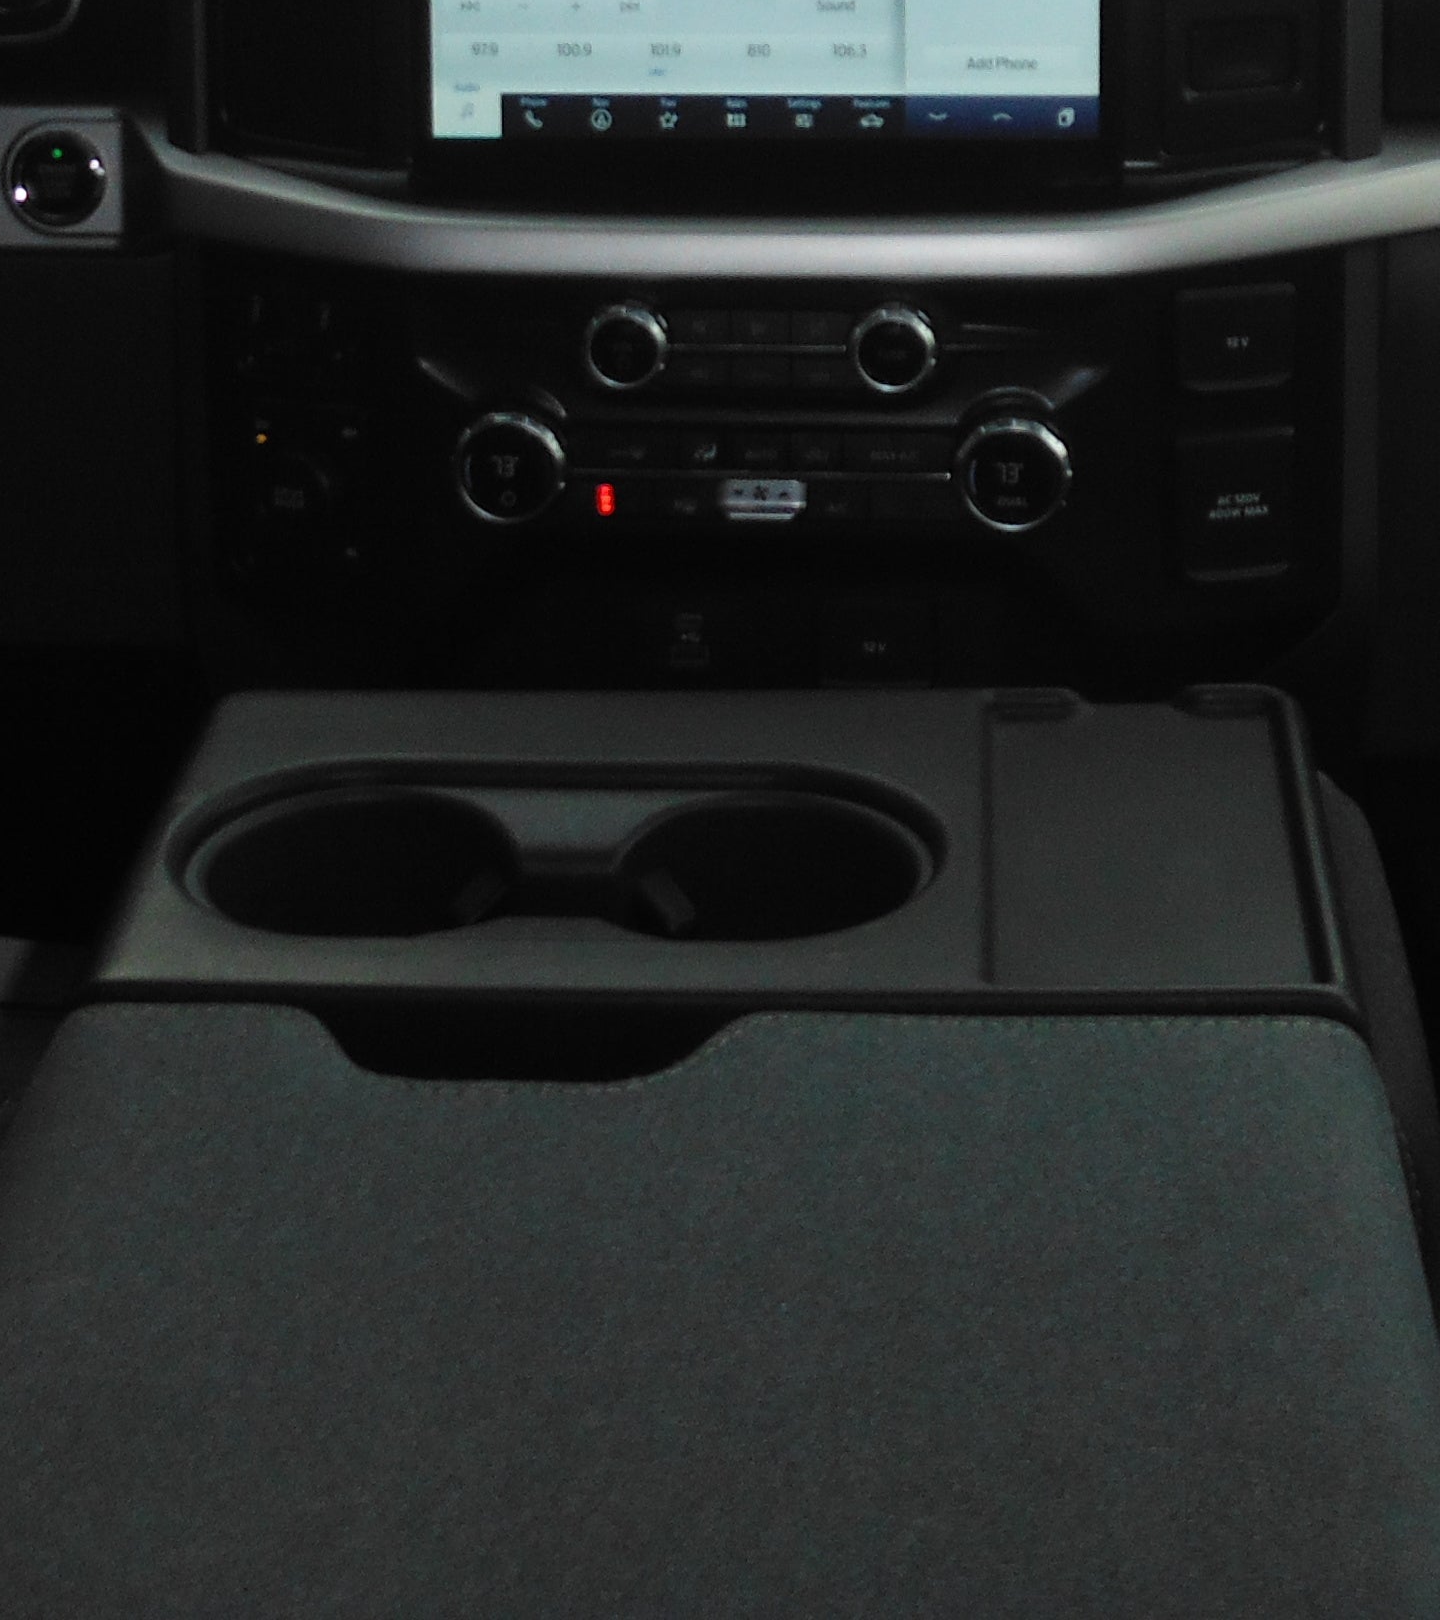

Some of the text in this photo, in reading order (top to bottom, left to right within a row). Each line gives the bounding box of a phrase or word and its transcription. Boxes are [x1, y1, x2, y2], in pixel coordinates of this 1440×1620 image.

[556, 42, 592, 57] 100.9
[966, 54, 1039, 71] Add Phone
